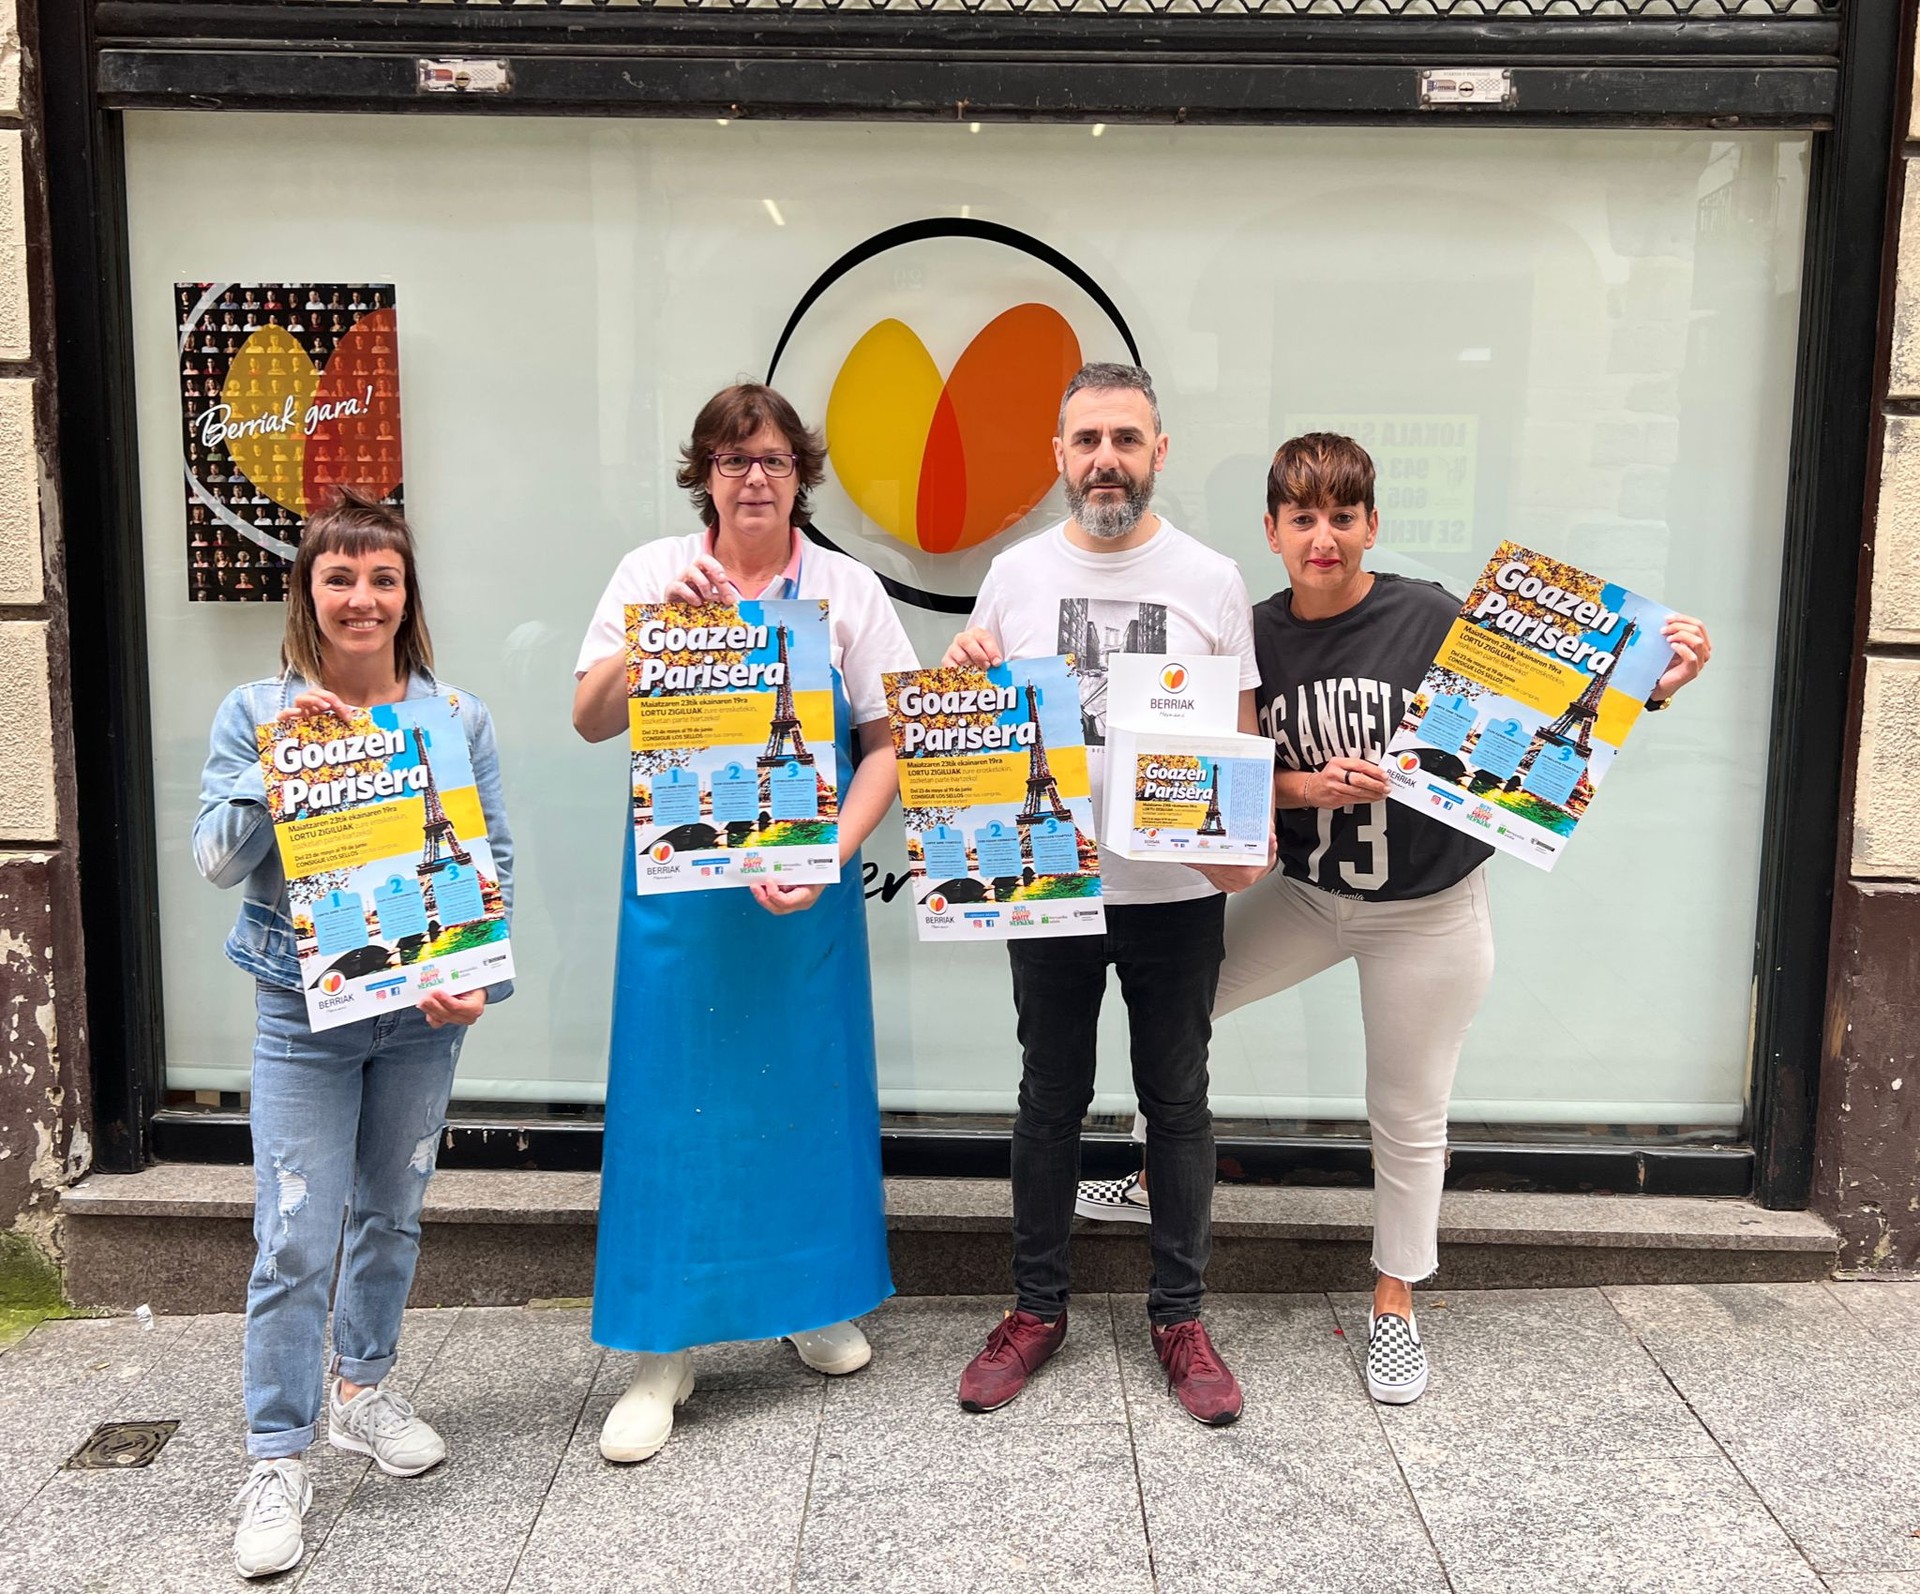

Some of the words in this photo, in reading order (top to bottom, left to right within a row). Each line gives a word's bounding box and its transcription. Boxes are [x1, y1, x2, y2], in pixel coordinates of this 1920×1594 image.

[196, 395, 298, 446] Berriak
[304, 385, 374, 435] gara!
[1495, 562, 1619, 634] Goazen
[638, 620, 768, 652] Goazen
[1473, 590, 1616, 675] Parisera
[1459, 632, 1484, 648] LORTU
[1483, 643, 1517, 663] ZIGILUAK
[1464, 625, 1501, 646] Maiatzaren
[1500, 642, 1517, 654] 23tik
[1516, 649, 1548, 668] ekainaren
[1548, 664, 1563, 675] 19ra
[640, 655, 786, 691] Parisera
[1447, 655, 1475, 671] CONSIGUE
[1474, 667, 1485, 676] LOS
[1485, 672, 1504, 684] SELLOS
[900, 685, 1016, 716] Goazen
[1150, 698, 1194, 710] BERRIAK
[1452, 697, 1462, 711] 1
[1298, 677, 1416, 766] ANGEL
[1504, 722, 1518, 736] 2
[904, 718, 1036, 751] Parisera
[274, 728, 405, 774] Goazen
[1558, 747, 1573, 762] 3
[788, 764, 799, 778] 3
[907, 761, 940, 769] Maiatzaren
[931, 768, 961, 776] ZIGILUAK
[1146, 763, 1207, 781] Goazen
[670, 769, 678, 783] 1
[728, 766, 740, 780] 2
[282, 764, 428, 814] Parisera
[1144, 782, 1214, 800] Parisera
[290, 831, 317, 842] LORTU
[318, 823, 354, 836] ZIGILUAK
[938, 826, 946, 840] 1
[990, 824, 1002, 838] 2
[1046, 819, 1058, 834] 3
[449, 866, 460, 880] 3
[647, 866, 680, 875] BERRIAK
[390, 879, 402, 894] 2
[330, 893, 340, 908] 1
[926, 916, 955, 924] BERRIAK
[318, 994, 354, 1009] BERRIAK
